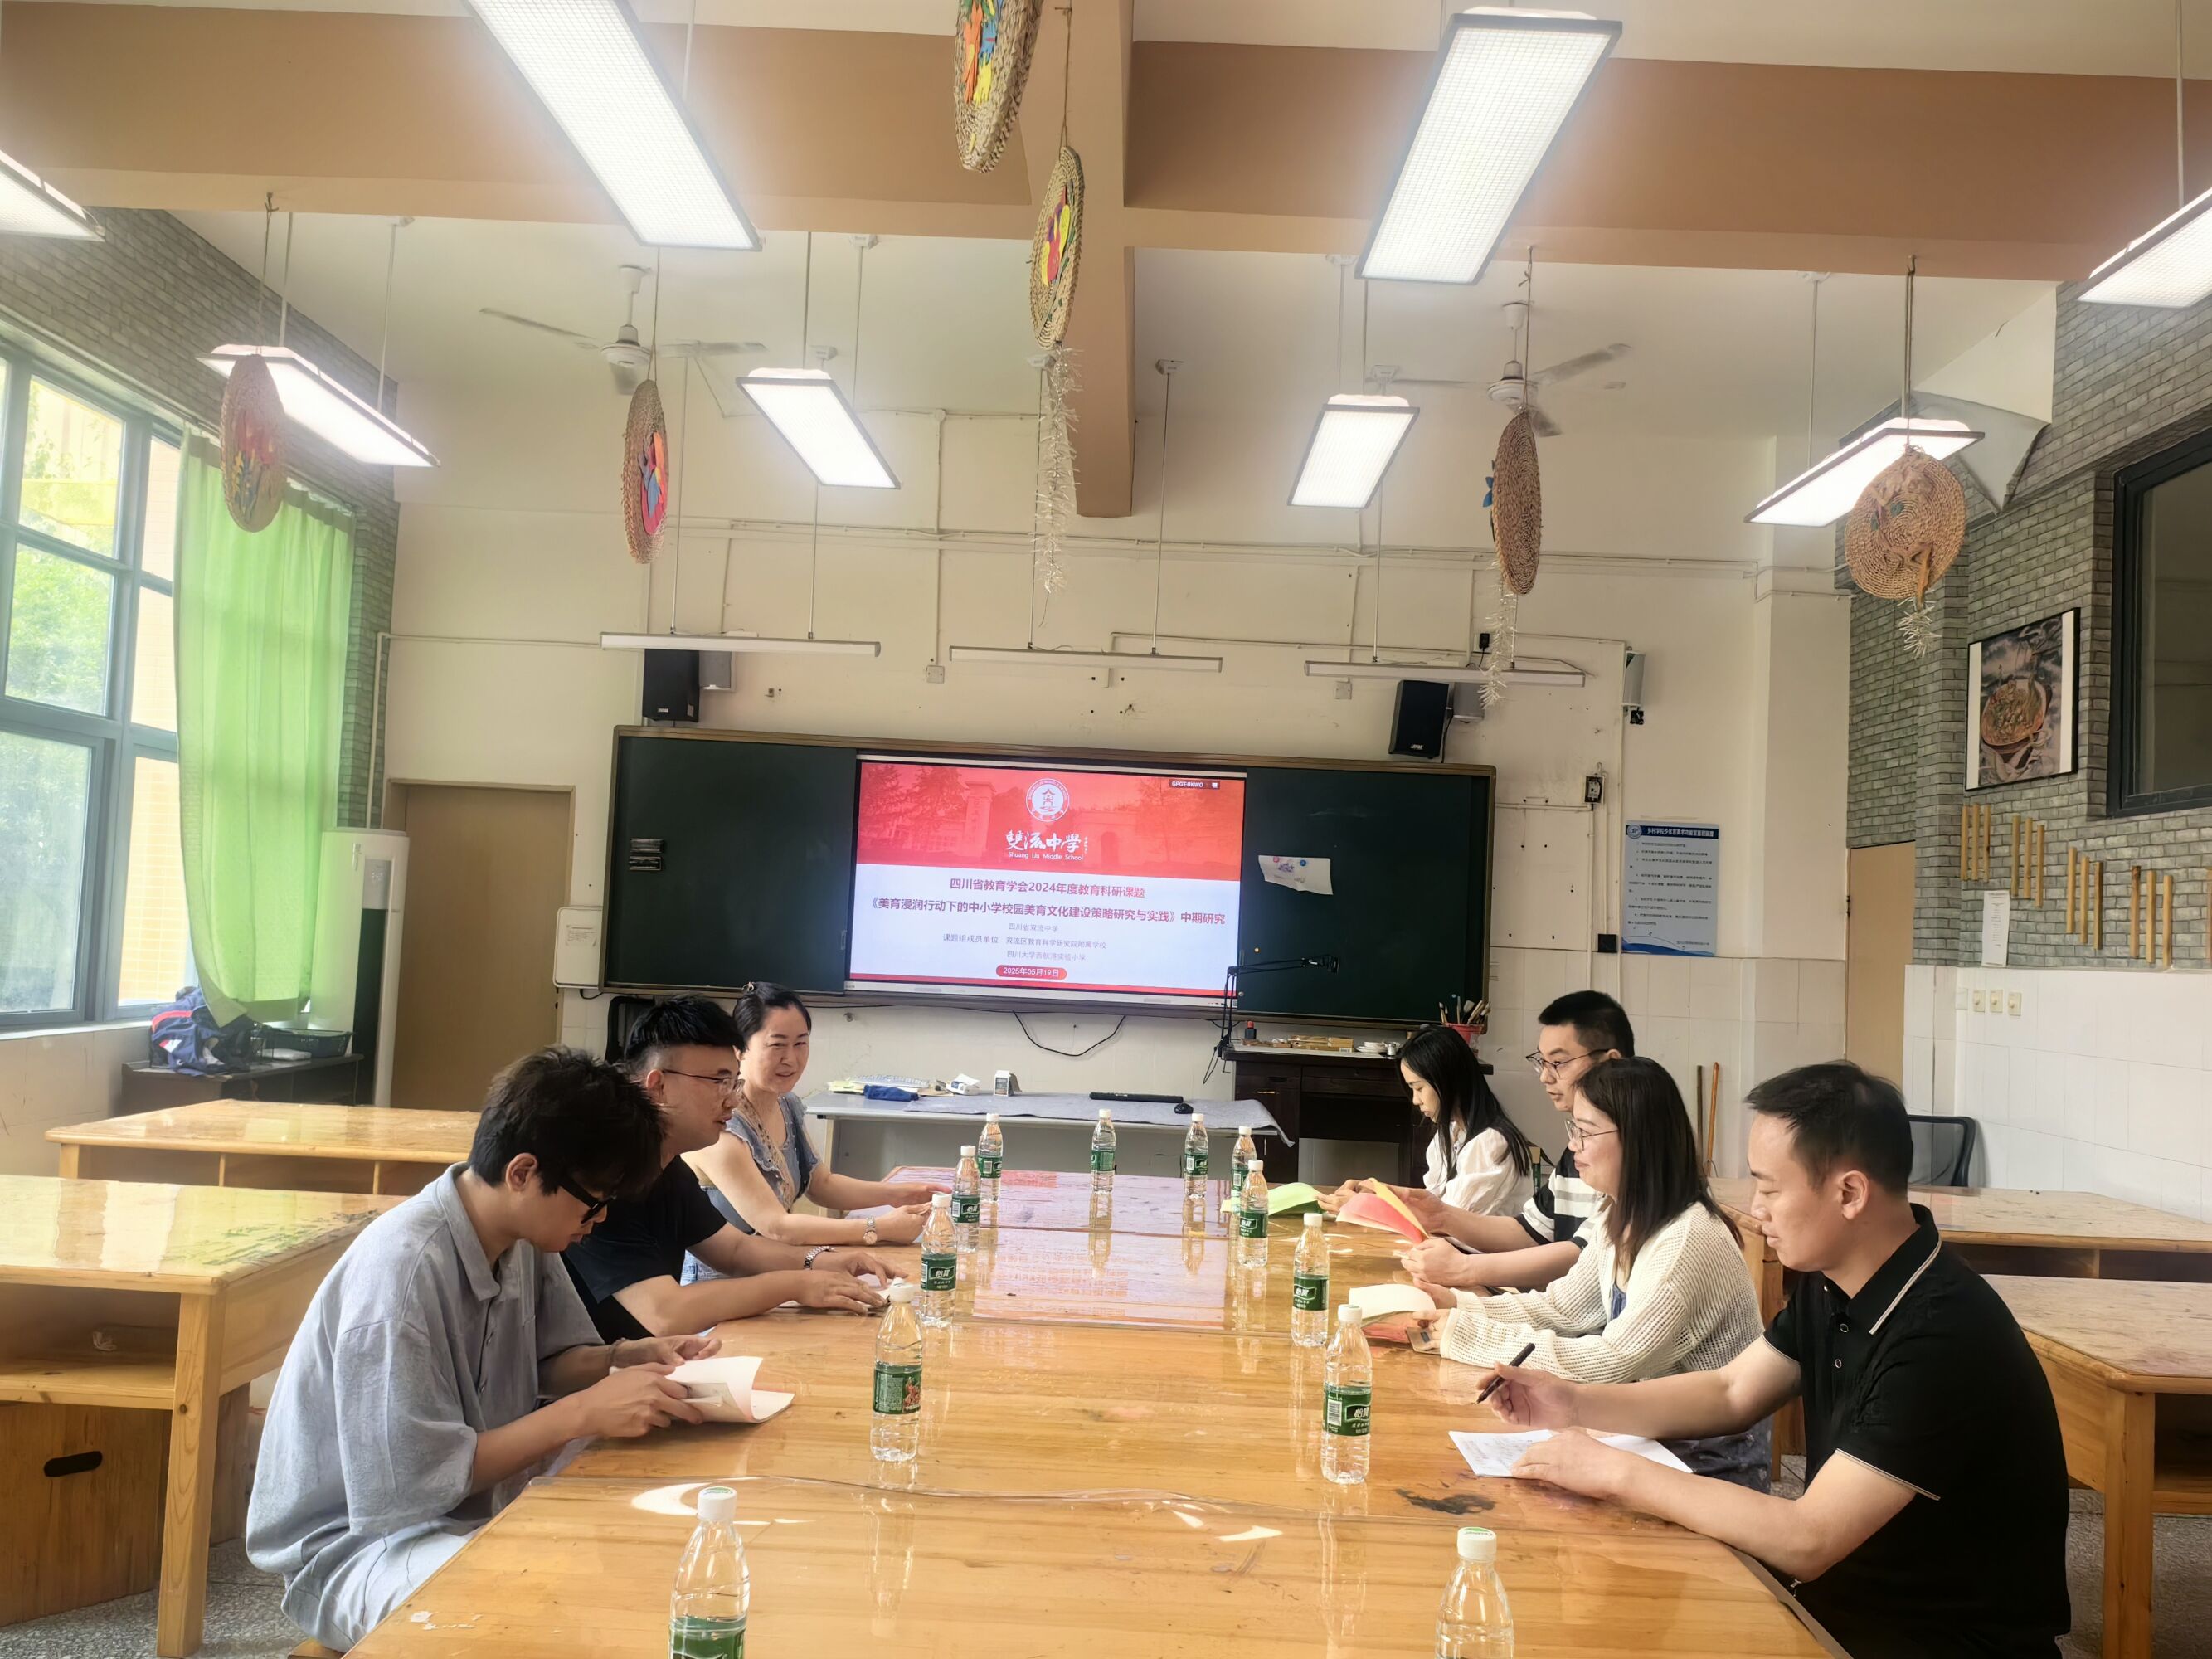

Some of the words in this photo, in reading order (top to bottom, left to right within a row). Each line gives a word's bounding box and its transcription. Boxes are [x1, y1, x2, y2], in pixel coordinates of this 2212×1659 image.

[1008, 851, 1029, 859] Shuang
[950, 878, 1145, 898] 四川省教育学会2024年度教育科研课题
[1008, 922, 1058, 932] 四川省双流中学
[1003, 966, 1059, 977] 2025年05月19日
